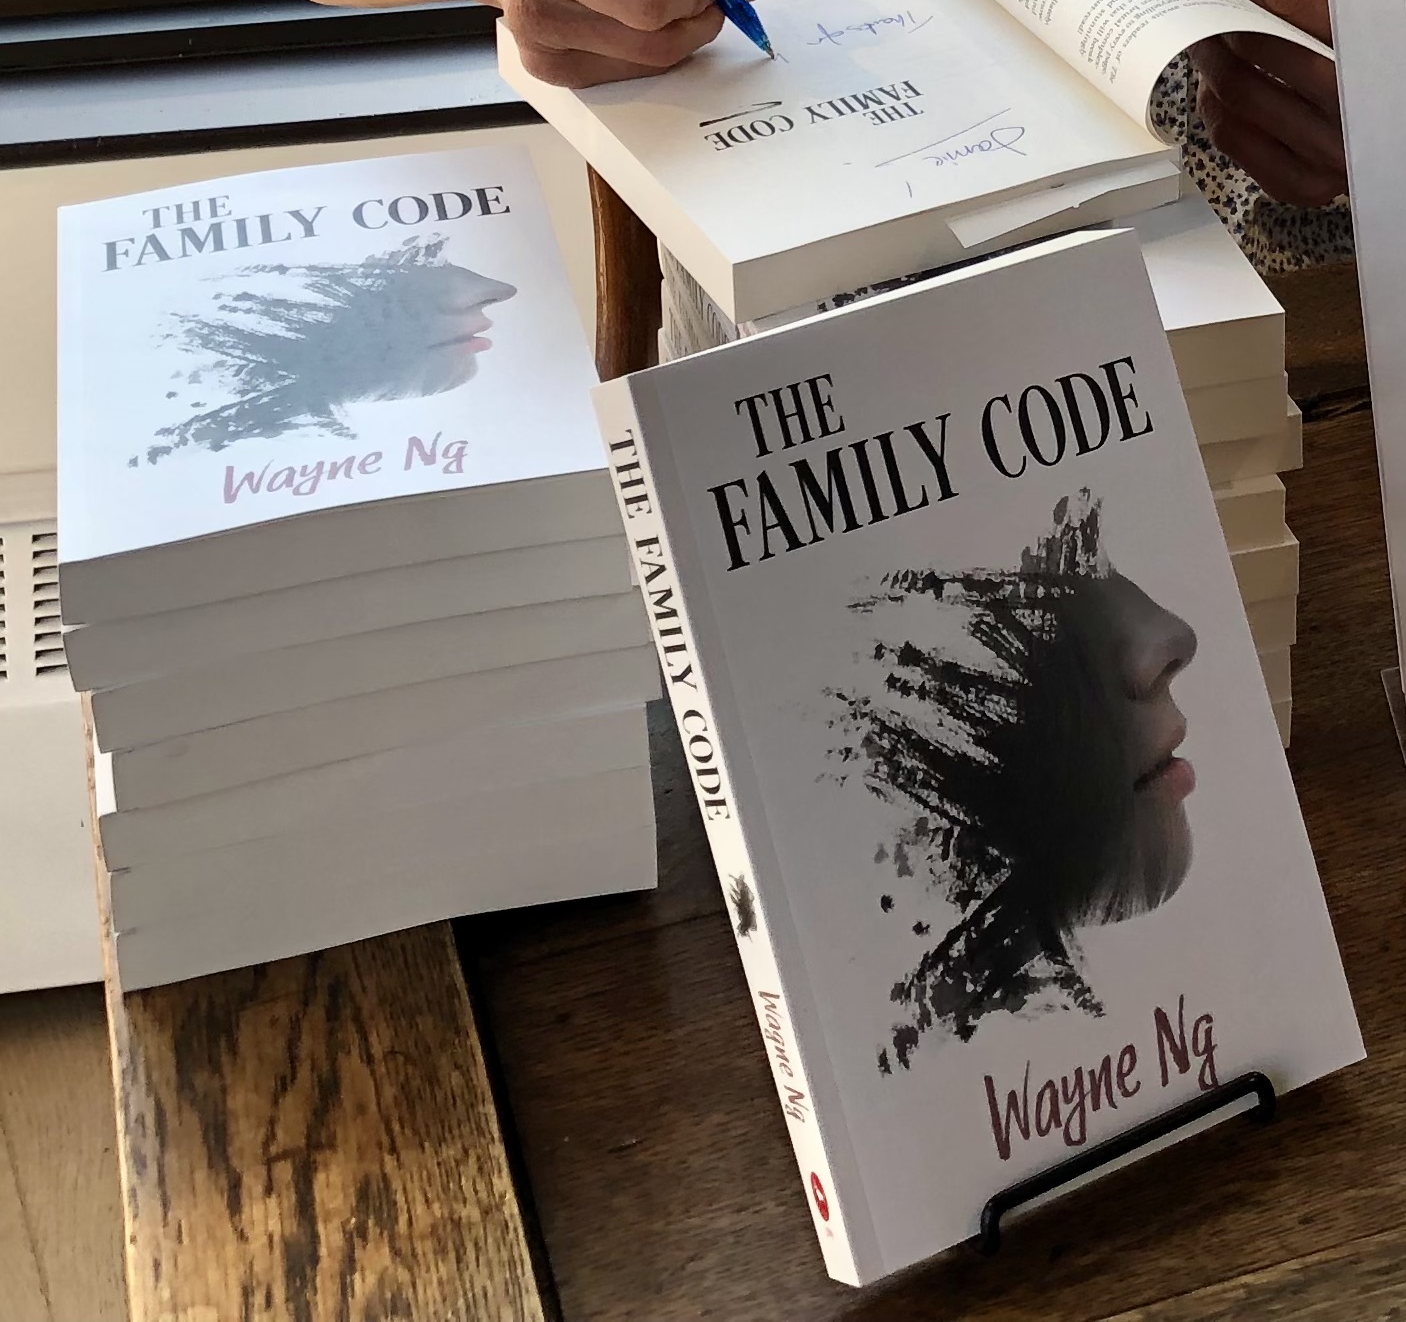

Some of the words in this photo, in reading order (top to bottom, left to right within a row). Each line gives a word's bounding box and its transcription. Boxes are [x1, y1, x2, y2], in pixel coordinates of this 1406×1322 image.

[703, 113, 795, 153] CODE
[800, 79, 925, 125] FAMILY
[861, 101, 925, 127] THE
[101, 205, 328, 273] FAMILY
[352, 185, 512, 231] CODE
[142, 194, 234, 230] THE
[734, 373, 846, 459] THE
[222, 448, 384, 504] Wayne
[404, 430, 470, 475] Ng
[707, 412, 960, 573] FAMILY
[981, 355, 1154, 480] CODE
[608, 428, 653, 520] THE
[634, 533, 699, 691] FAMILY
[681, 708, 731, 822] CODE
[757, 990, 795, 1079] Wayne
[785, 1087, 810, 1124] Ng
[984, 1060, 1141, 1161] Wayne
[1154, 994, 1219, 1091] Ng
